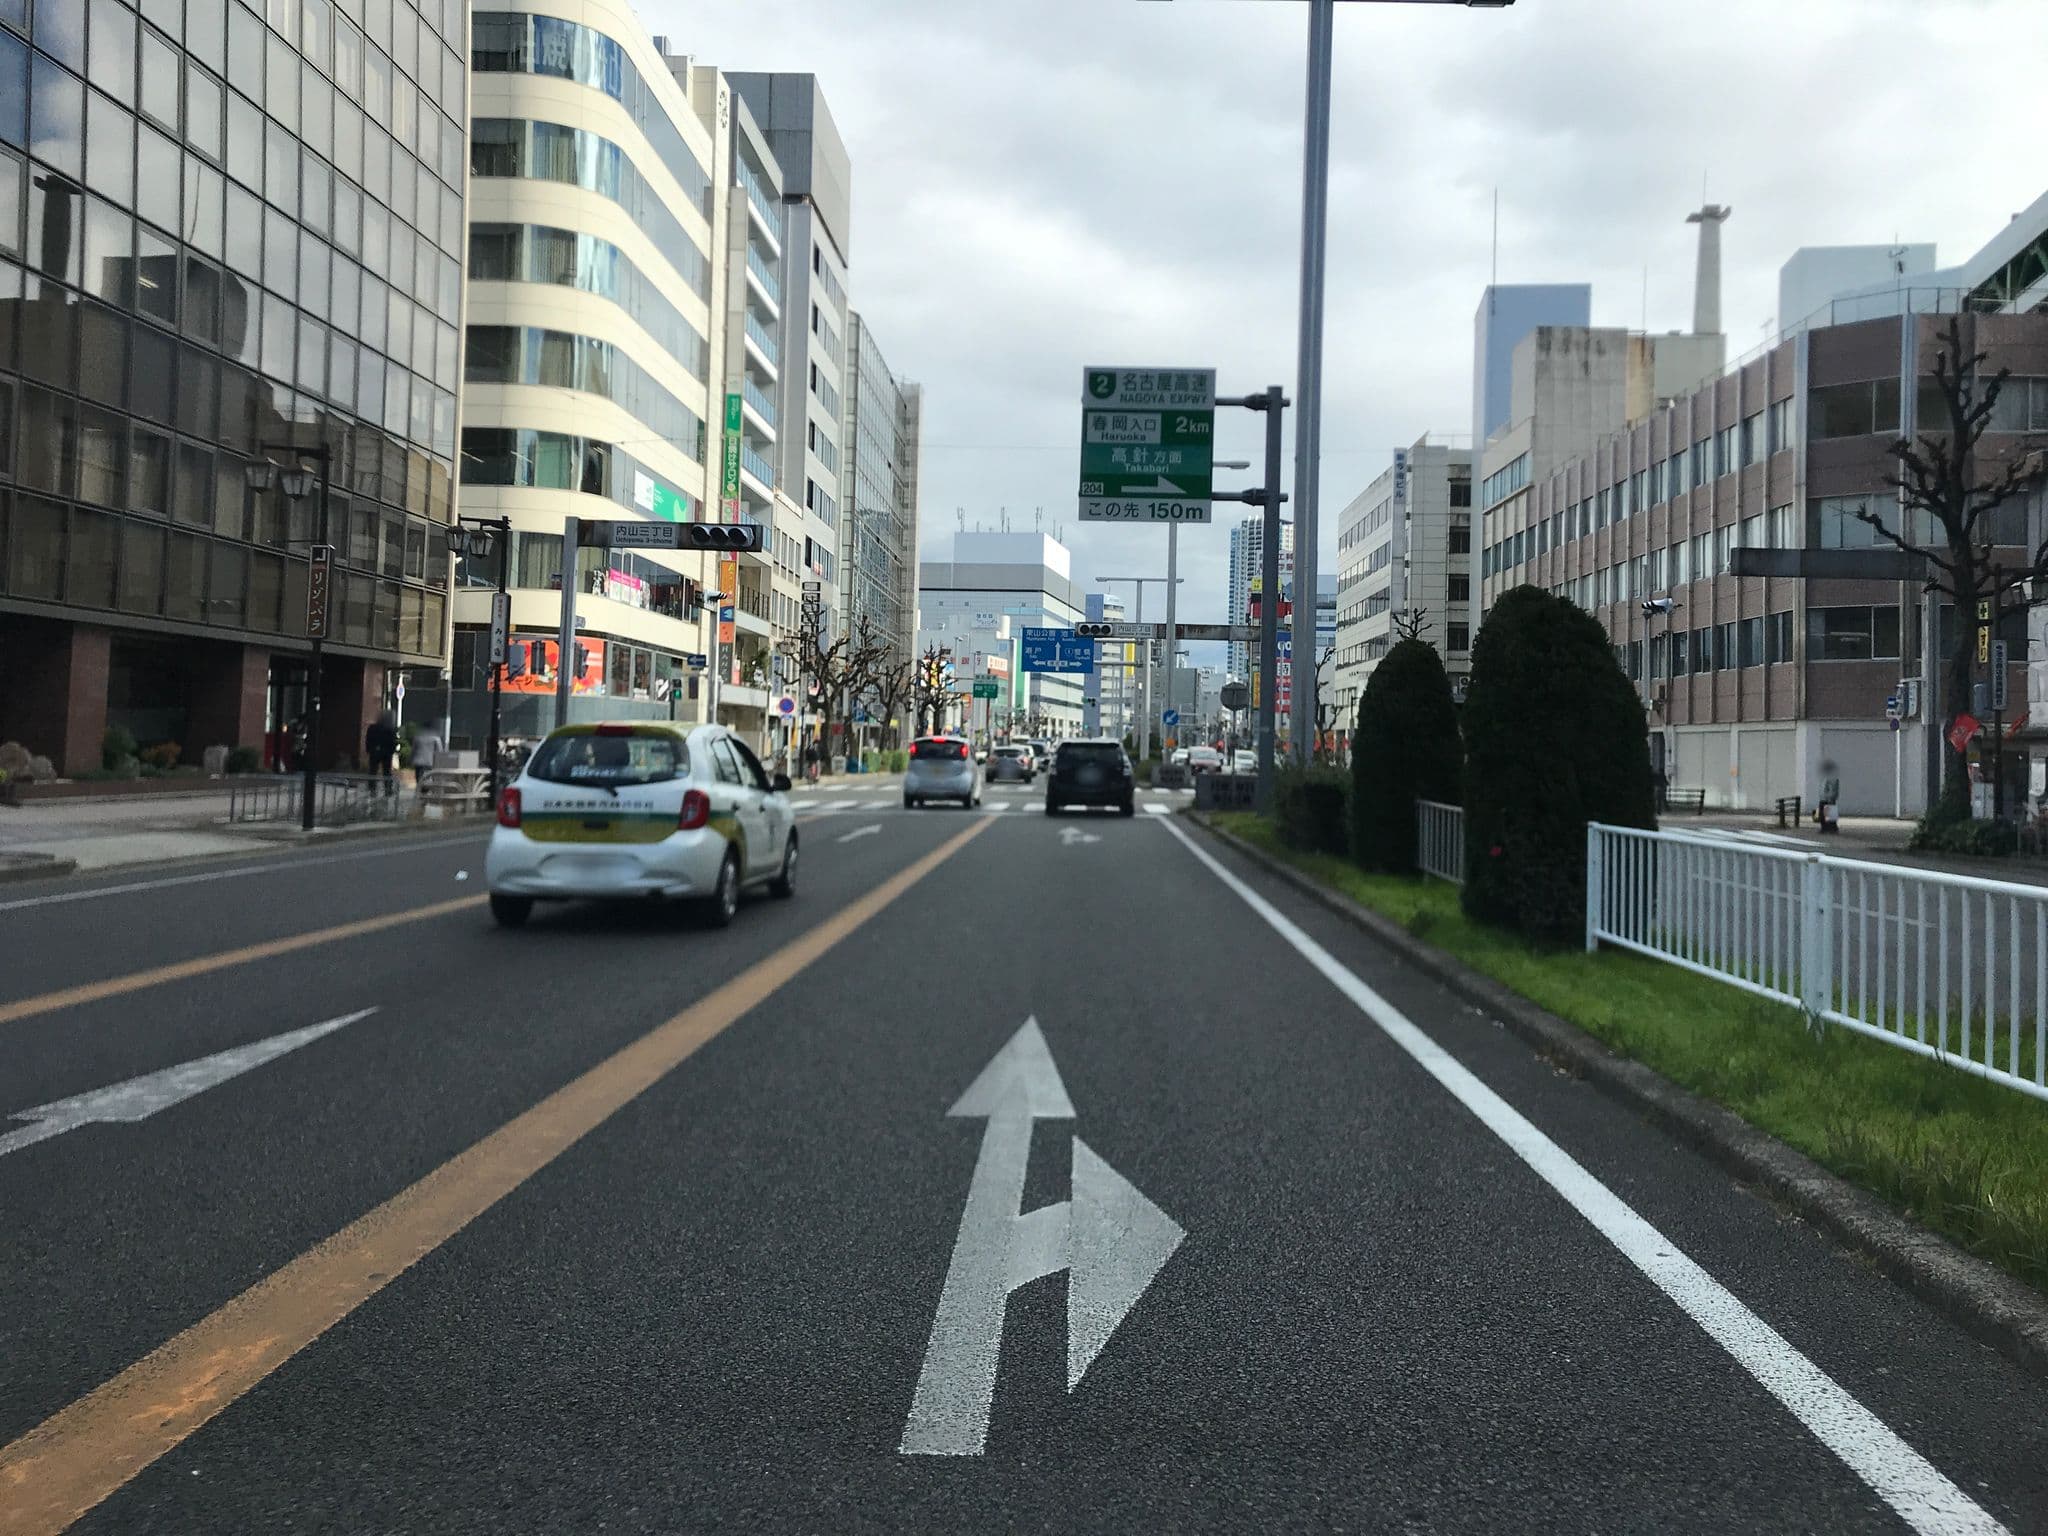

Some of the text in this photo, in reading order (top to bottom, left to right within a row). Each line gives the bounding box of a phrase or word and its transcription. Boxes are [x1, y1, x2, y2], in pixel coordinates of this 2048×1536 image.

[1095, 375, 1109, 394] 2
[1121, 373, 1208, 392] 名古屋高速
[1119, 393, 1208, 404] NAGOYA EXPWY
[1092, 415, 1157, 432] 春岡入口
[1175, 416, 1209, 433] 2km
[1100, 432, 1147, 441] Haruoka
[1111, 447, 1183, 464] 高針方面
[1082, 483, 1103, 494] 204
[1088, 502, 1203, 519] この先 150m
[616, 526, 673, 537] 内山三丁目
[615, 536, 644, 544] Uchiyama
[1118, 625, 1151, 633] 内山三丁目
